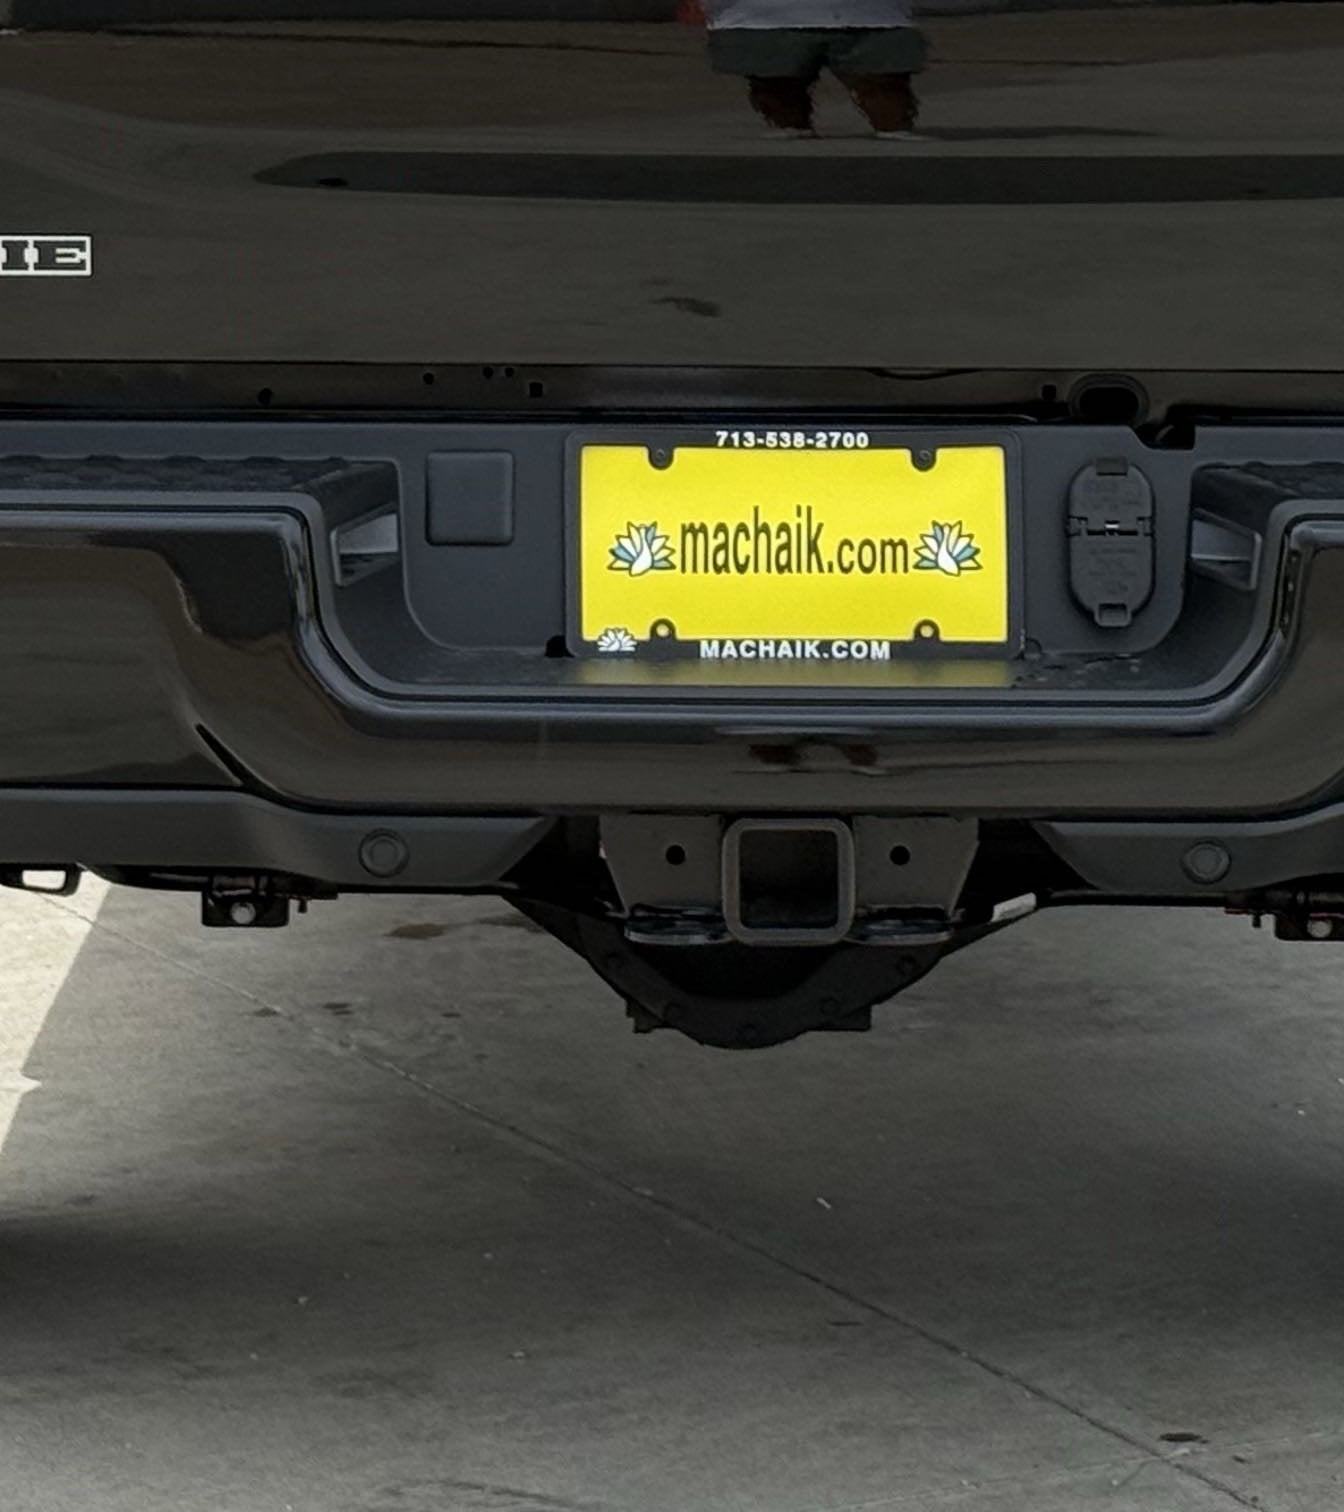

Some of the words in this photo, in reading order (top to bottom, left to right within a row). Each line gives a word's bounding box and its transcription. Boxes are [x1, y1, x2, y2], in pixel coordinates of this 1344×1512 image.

[715, 430, 870, 449] 713-538-2700
[679, 504, 910, 576] machaik.com
[699, 638, 891, 661] MACHAIK.COM
